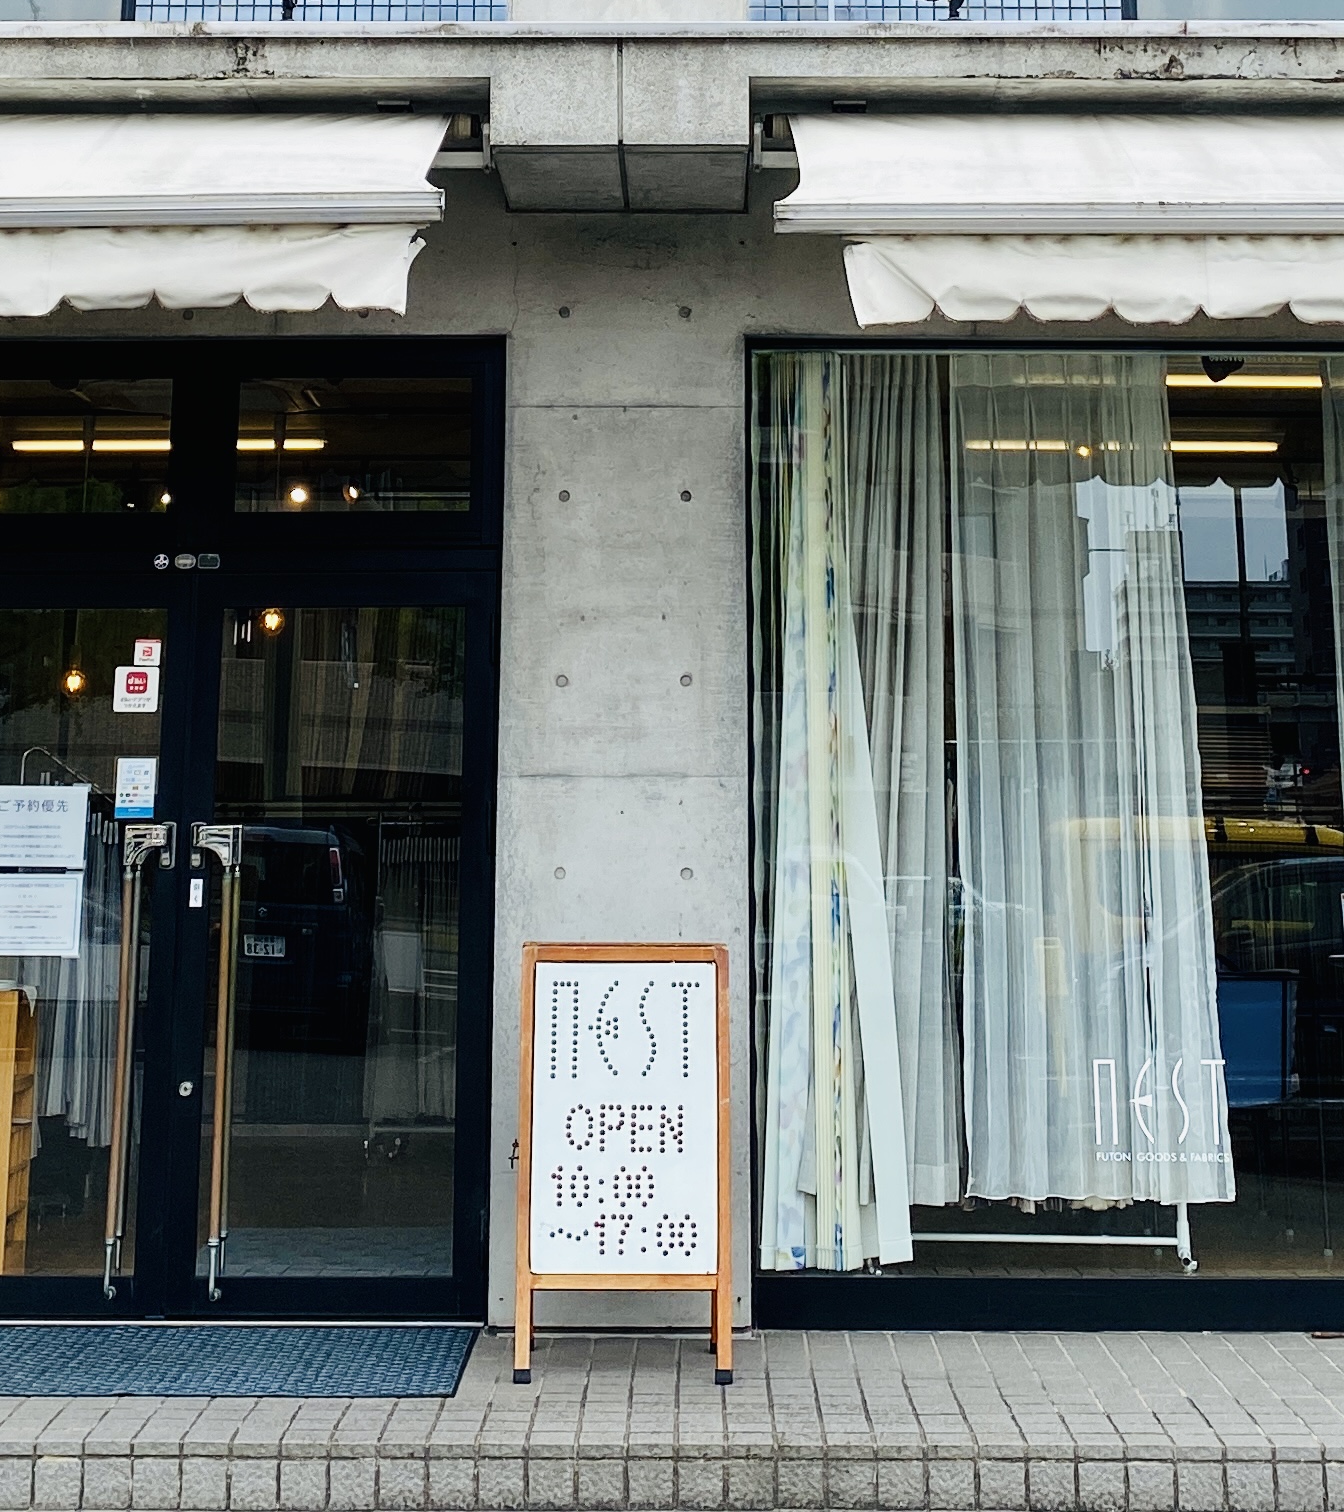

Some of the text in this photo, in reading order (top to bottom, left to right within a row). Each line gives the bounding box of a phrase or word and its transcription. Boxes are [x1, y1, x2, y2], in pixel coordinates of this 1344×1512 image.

[567, 1104, 684, 1153] OPEN
[1096, 1152, 1230, 1163] FUTON GOODS & FABRICS
